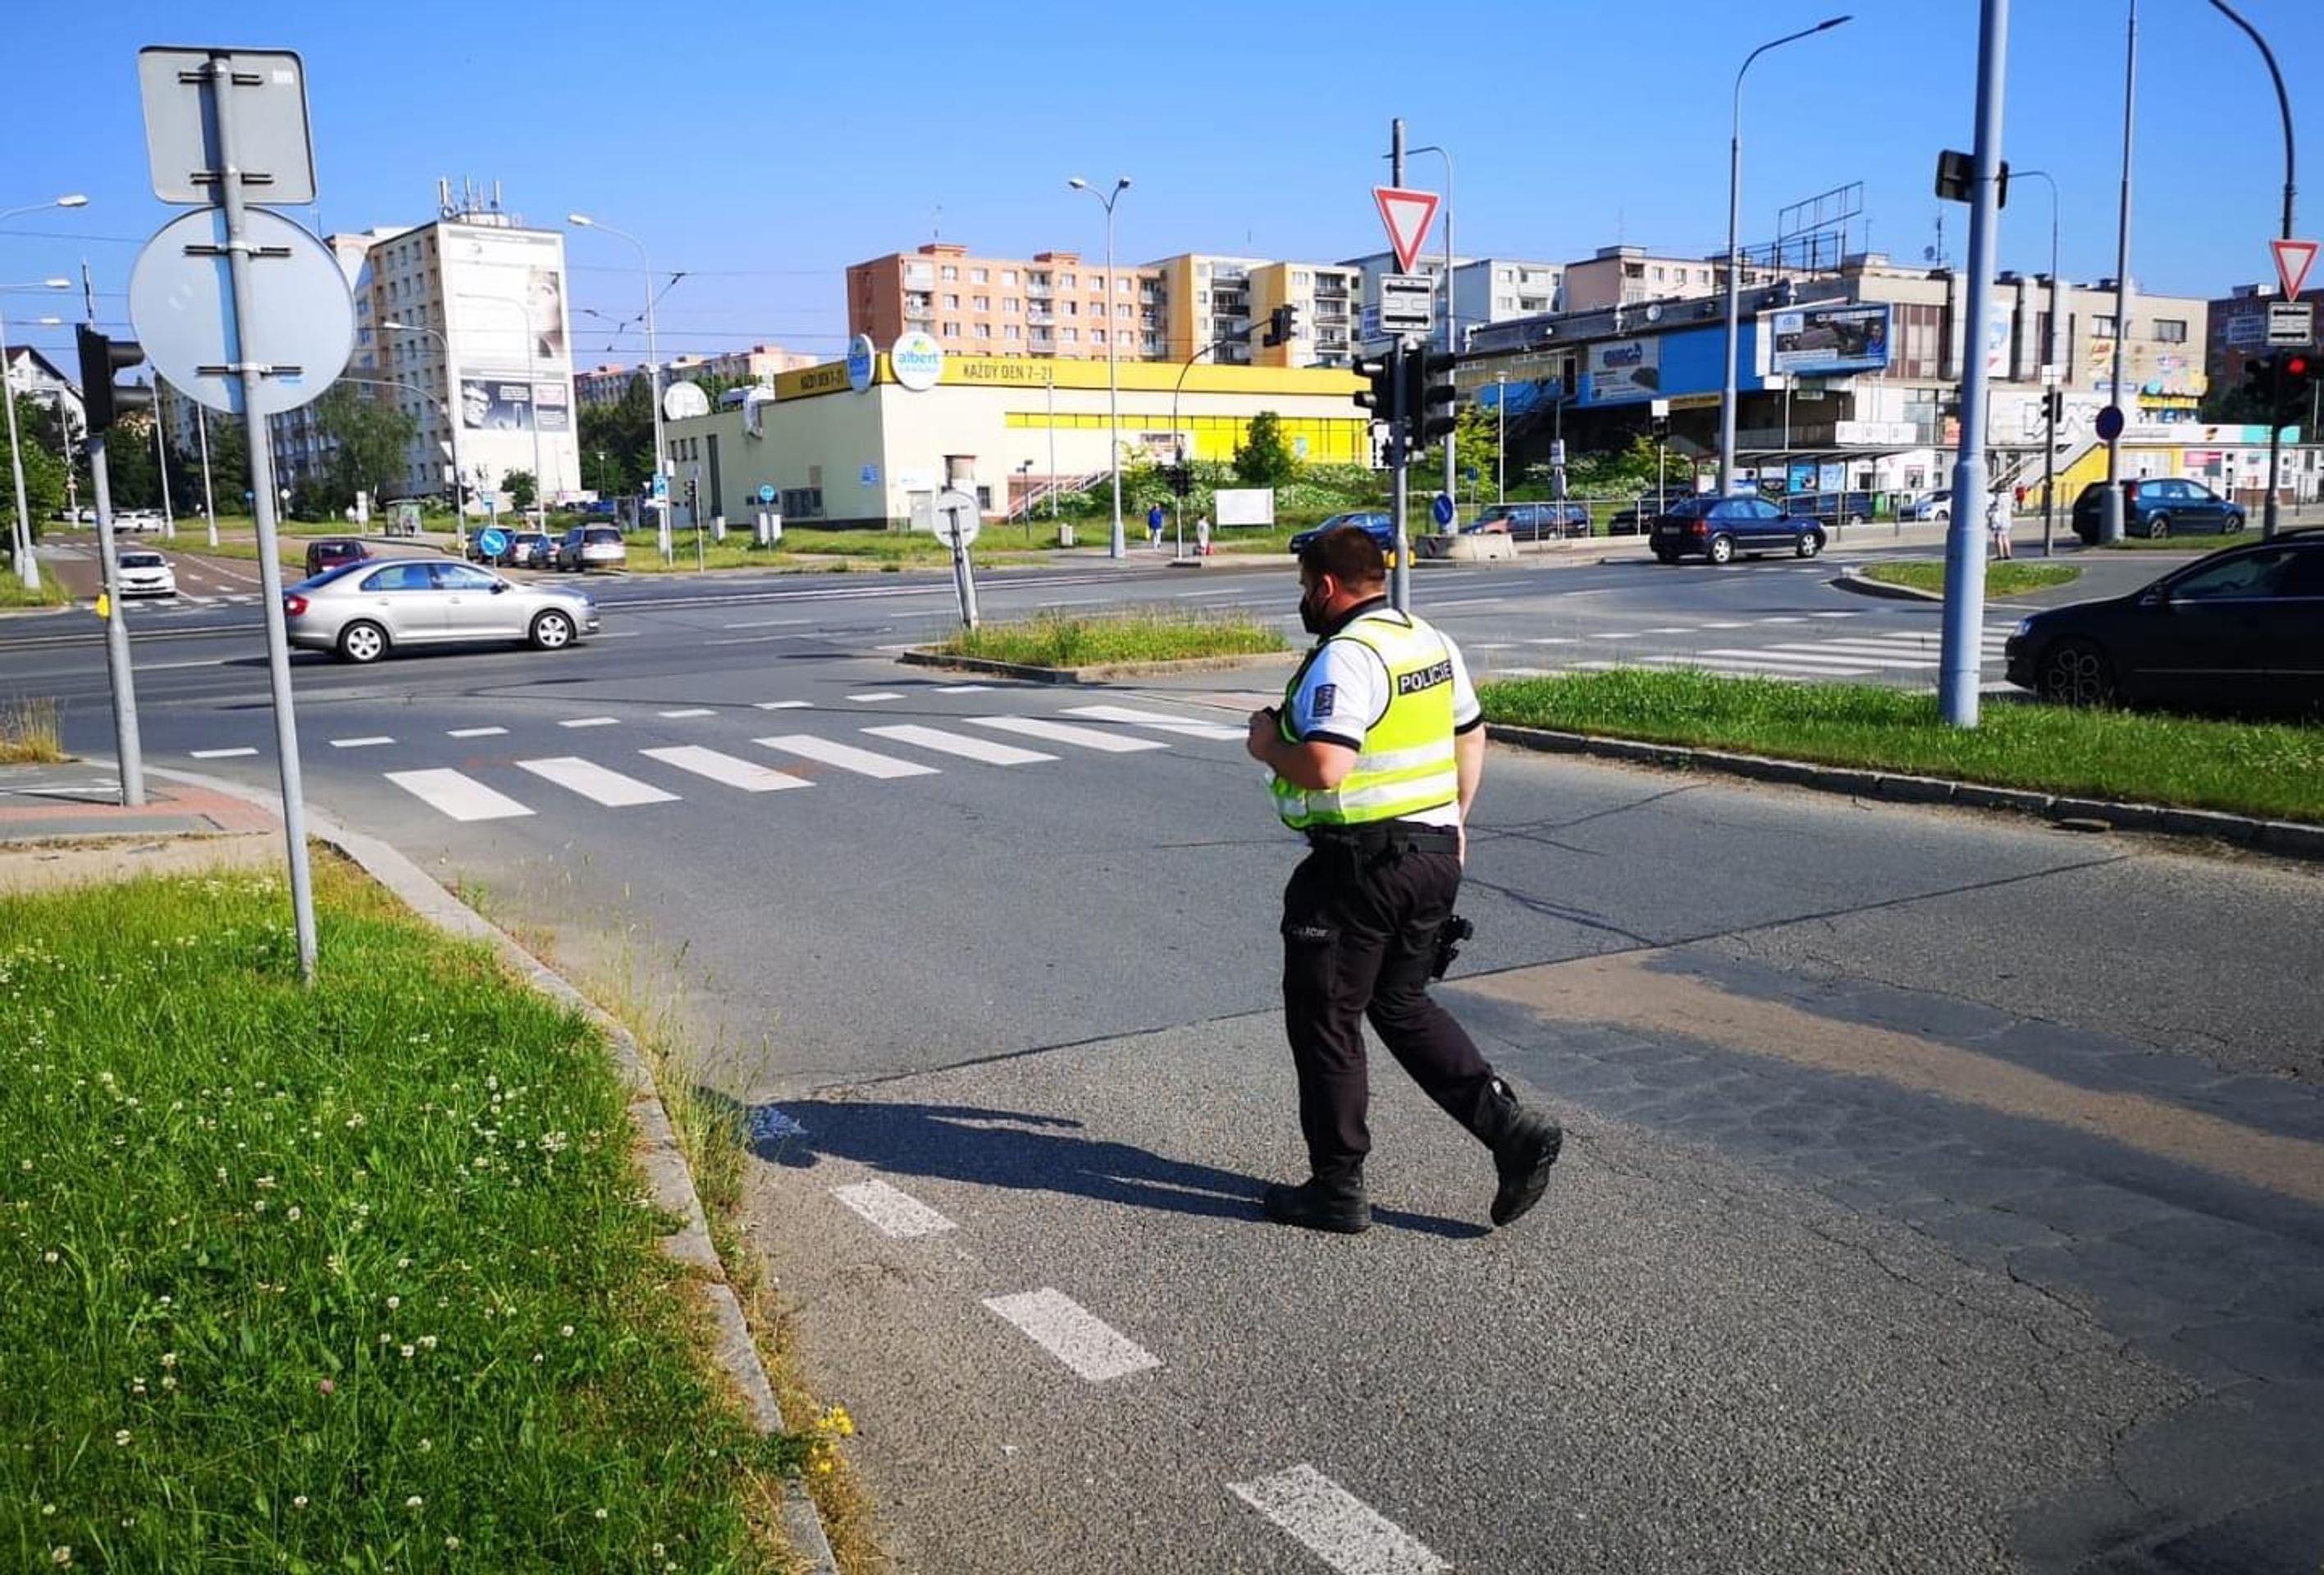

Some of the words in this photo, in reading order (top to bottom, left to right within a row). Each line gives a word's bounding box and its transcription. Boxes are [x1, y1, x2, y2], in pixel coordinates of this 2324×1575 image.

[897, 350, 938, 363] albert
[1001, 364, 1024, 378] DEN
[1400, 662, 1451, 692] POLICIE
